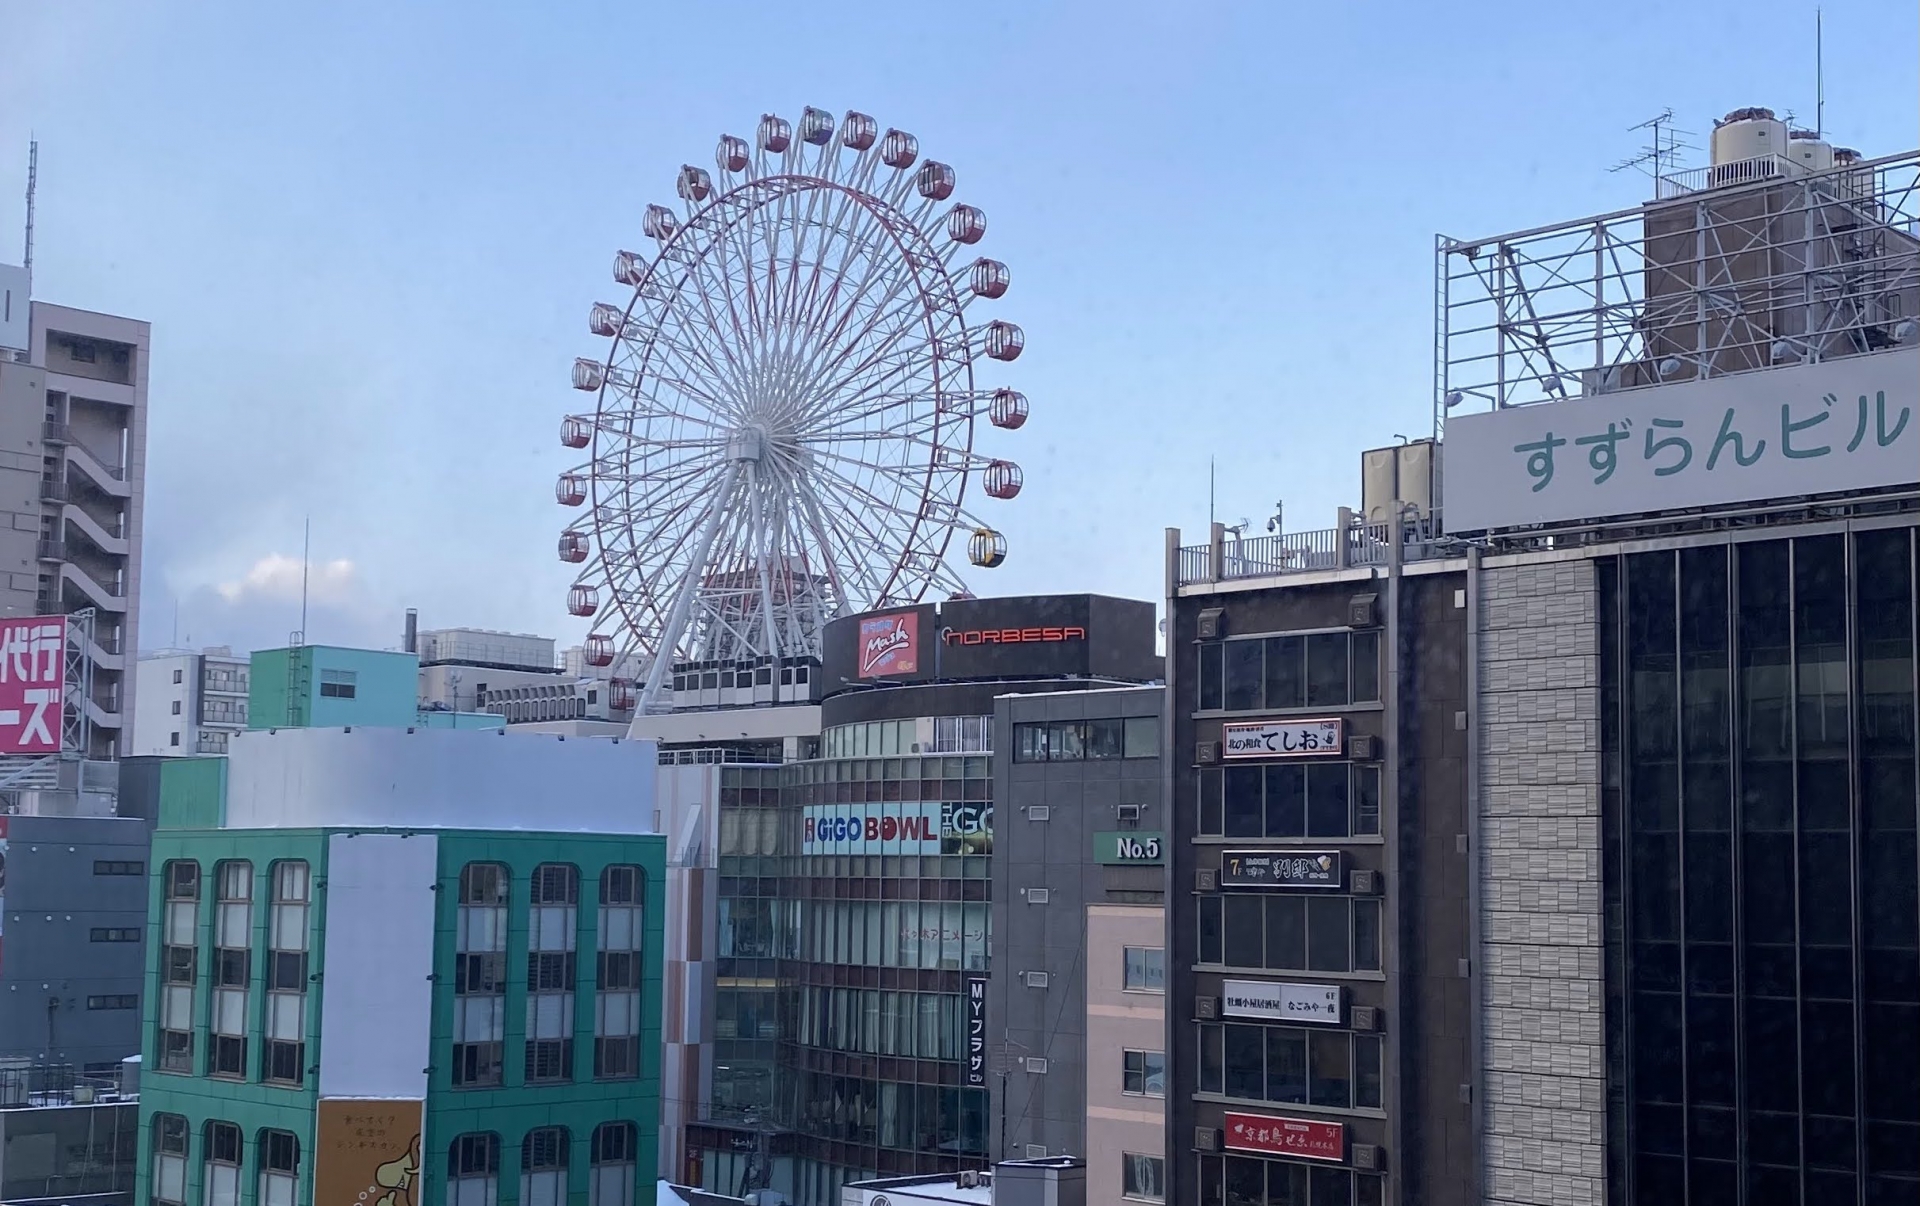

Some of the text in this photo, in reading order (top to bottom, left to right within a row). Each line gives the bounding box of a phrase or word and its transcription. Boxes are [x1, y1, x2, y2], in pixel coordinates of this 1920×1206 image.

[1514, 390, 1910, 492] すずらんビル
[863, 618, 909, 672] Mash
[945, 626, 1085, 646] NORBESA
[0, 625, 62, 683] 代行
[1261, 730, 1318, 751] てしお
[817, 816, 938, 842] GiGO BOWL
[941, 803, 952, 838] THE
[1116, 837, 1159, 859] No.5
[969, 983, 983, 1083] MYプラザビル
[1326, 1127, 1338, 1138] 5F
